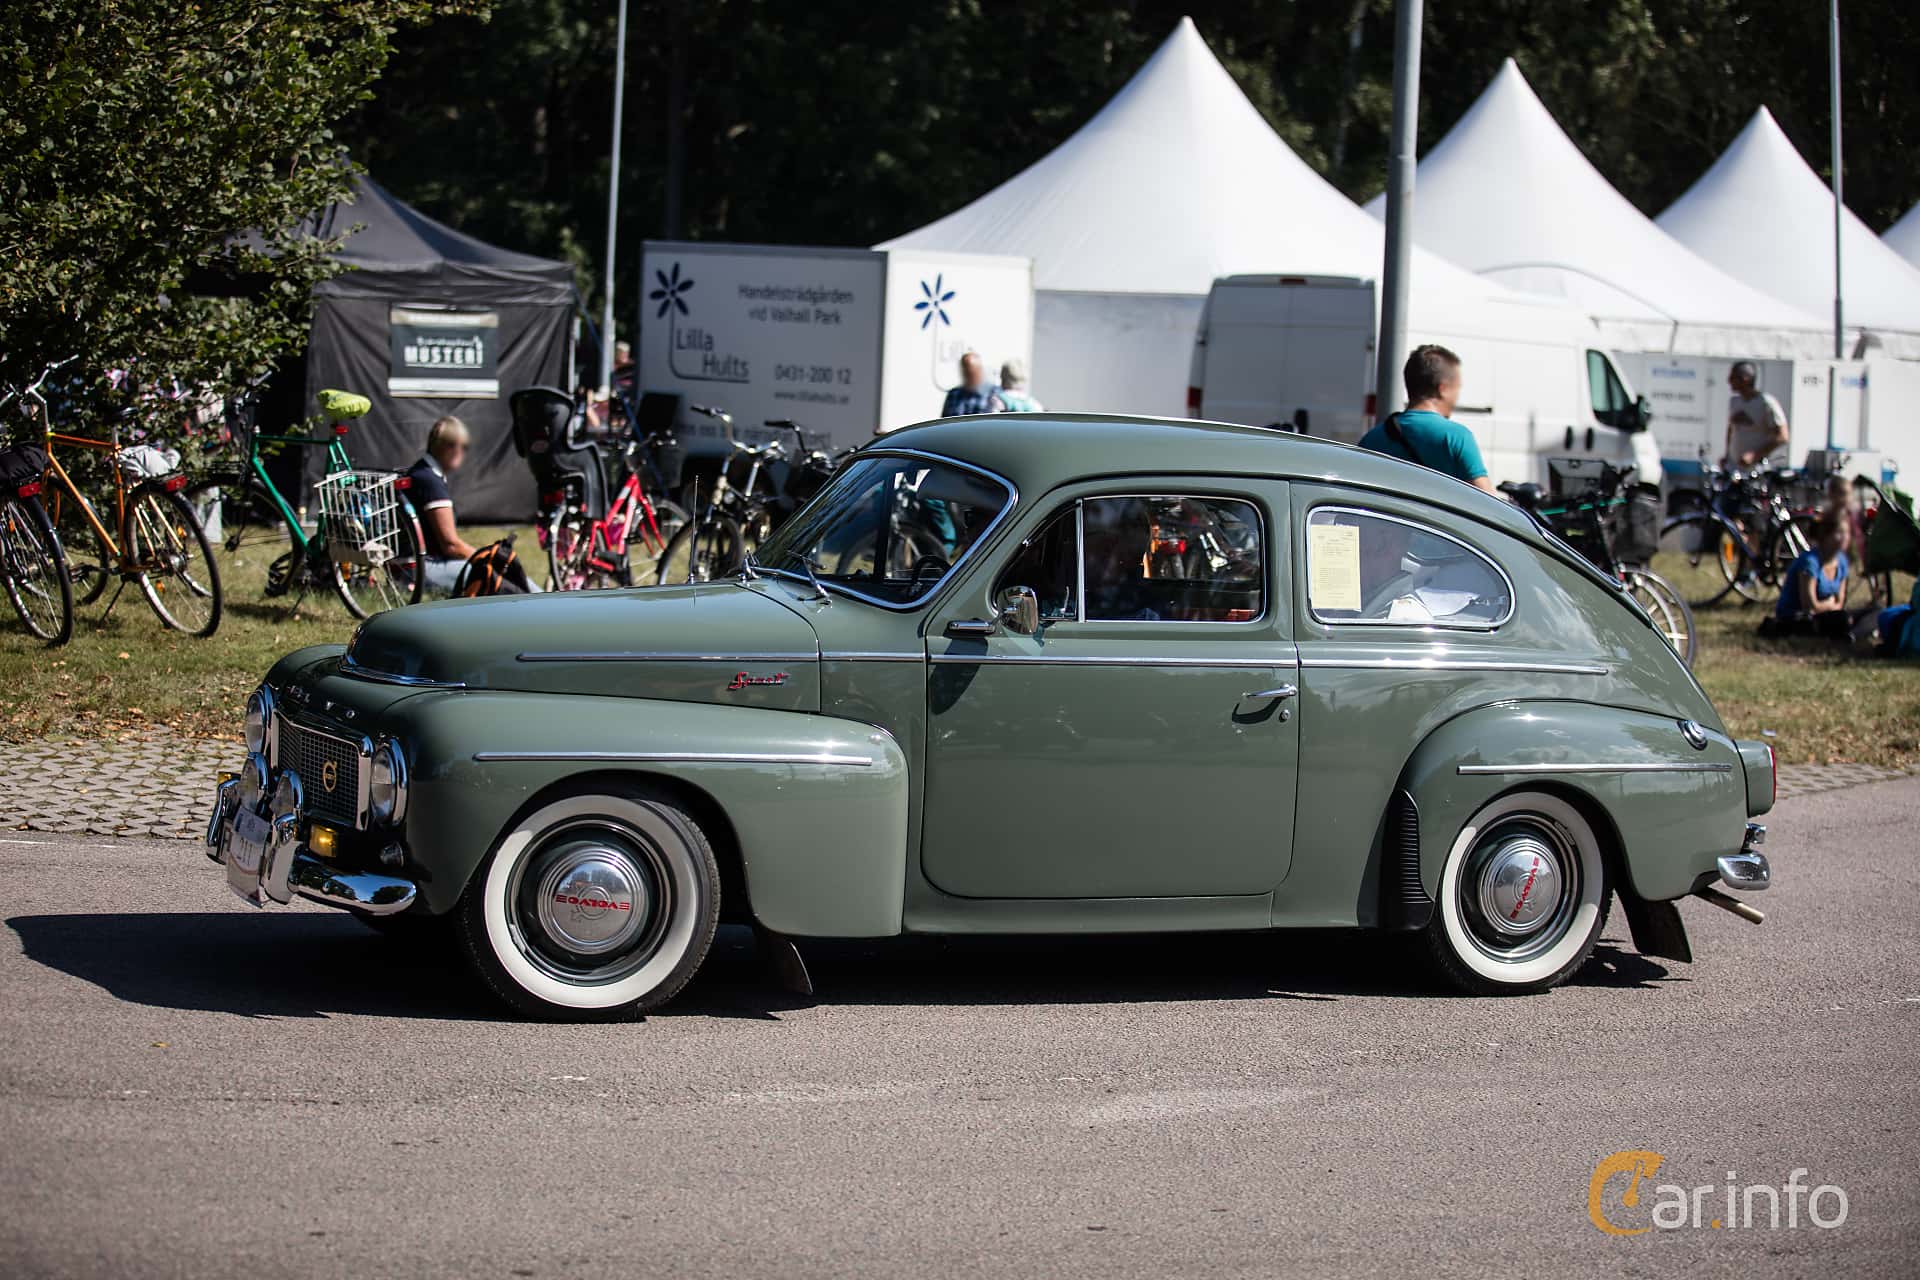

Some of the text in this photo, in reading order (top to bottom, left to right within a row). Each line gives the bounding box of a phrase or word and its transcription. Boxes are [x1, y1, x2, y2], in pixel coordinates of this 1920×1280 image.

[748, 306, 841, 325] vid Valhall Park
[676, 328, 714, 351] Lilla
[404, 346, 483, 365] MUSTERI
[702, 352, 750, 377] Hults
[837, 366, 852, 384] 12
